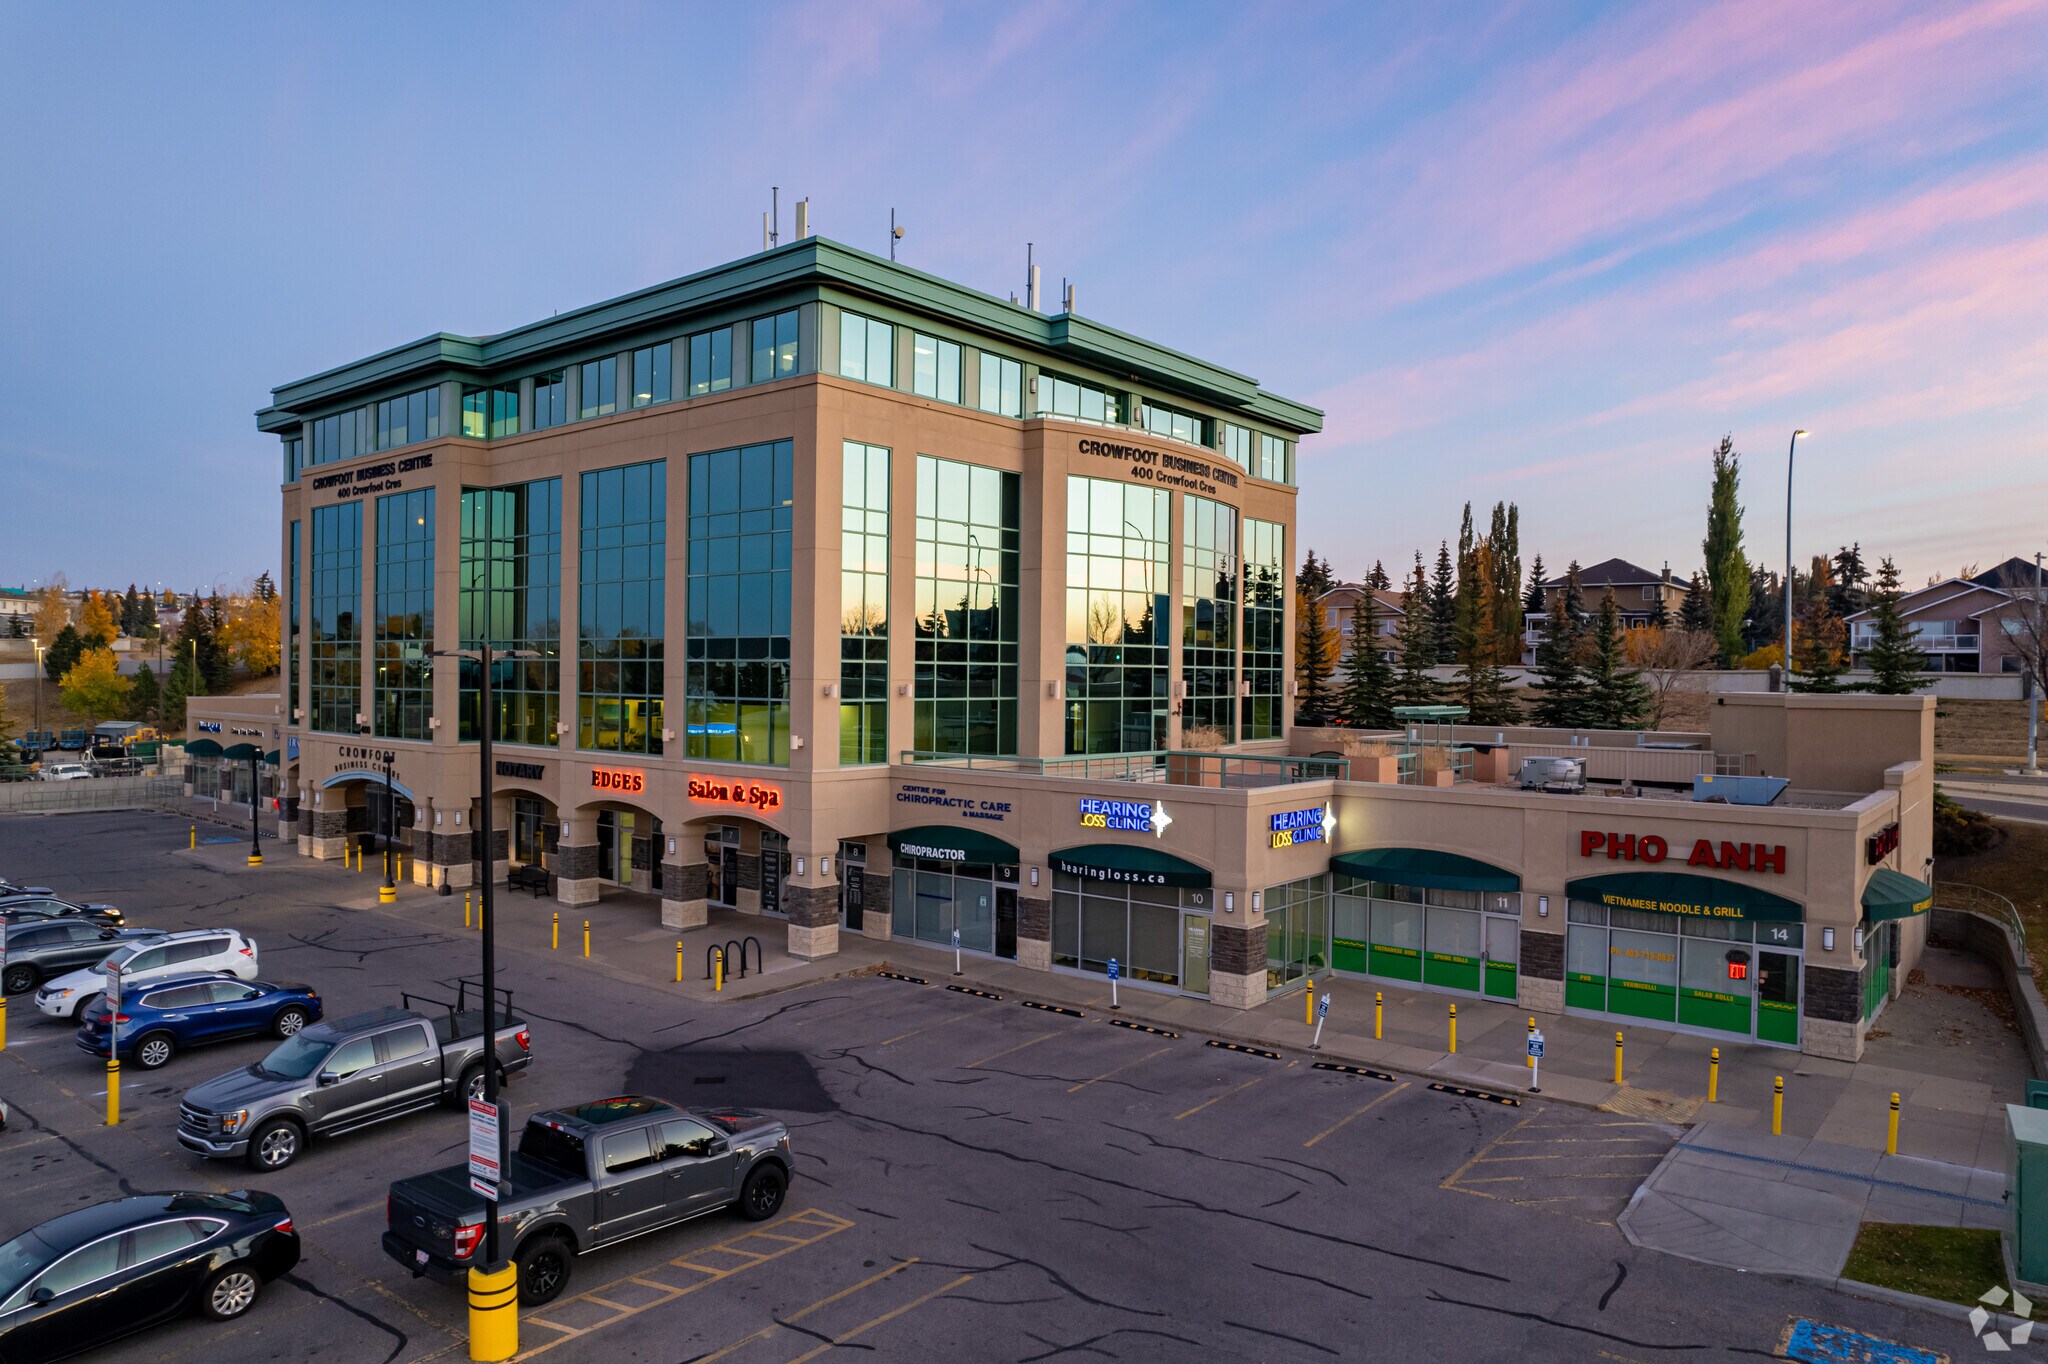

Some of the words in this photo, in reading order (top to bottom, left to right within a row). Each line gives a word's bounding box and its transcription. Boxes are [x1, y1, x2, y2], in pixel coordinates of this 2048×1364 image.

[312, 471, 354, 490] CROWFOOT
[356, 462, 395, 481] BUSINESS
[398, 454, 433, 474] CENTRE
[1078, 439, 1159, 465] CROWFOOT
[1162, 453, 1211, 478] BUSINESS
[1212, 467, 1238, 488] CENTRE
[337, 488, 351, 498] 400
[352, 481, 384, 496] Crowfoot
[385, 479, 402, 491] Cres
[1131, 466, 1153, 480] 400
[1156, 471, 1198, 490] Crowfoot
[1199, 480, 1216, 495] Cres
[335, 761, 368, 772] BUSINESS
[372, 763, 400, 780] CENRE
[496, 761, 545, 780] NOTARY
[591, 770, 642, 791] EDGES
[902, 785, 930, 794] CENTRE
[688, 780, 728, 801] Salon
[733, 785, 746, 802] &
[749, 787, 779, 809] Spa
[896, 793, 975, 809] CHIROPRACTIC
[980, 801, 1011, 812] CARE
[969, 811, 1004, 821] MASSAGE
[1080, 798, 1150, 819] HEARING
[1080, 814, 1106, 828] LOSS
[1106, 816, 1150, 831] CLINIC
[1272, 808, 1323, 831] HEARING
[1272, 831, 1292, 848] LOSS
[1292, 826, 1323, 844] CLINIC
[853, 847, 858, 856] 8
[900, 842, 965, 860] CHIROPRACTOR
[1580, 830, 1668, 863] PHO
[1687, 838, 1786, 874] ANH
[1004, 867, 1011, 877] 9
[1061, 861, 1165, 884] hearingloss.ca
[1191, 893, 1203, 904] 10
[1497, 897, 1508, 908] 11
[1602, 894, 1657, 910] VIETNAMESE
[1659, 902, 1701, 915] NOODLE
[1703, 906, 1711, 916] &
[1713, 906, 1744, 918] GRILL
[1770, 928, 1788, 940] 14
[1622, 981, 1657, 991] VERMICELLI
[1693, 990, 1713, 999] SALAD
[1715, 993, 1734, 1002] ROLLS
